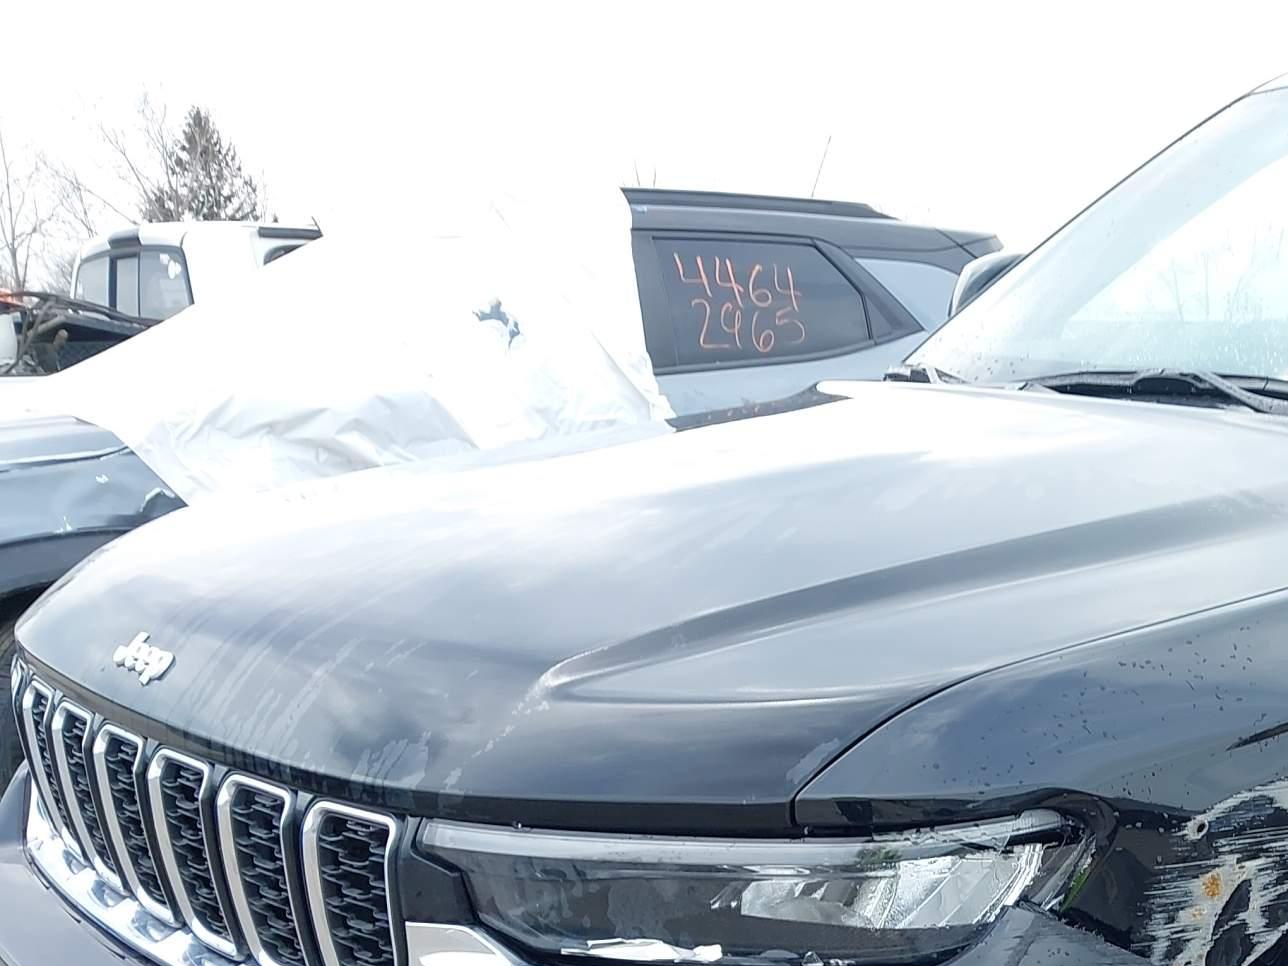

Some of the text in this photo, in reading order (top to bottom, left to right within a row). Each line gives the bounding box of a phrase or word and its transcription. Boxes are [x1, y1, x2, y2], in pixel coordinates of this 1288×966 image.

[673, 252, 802, 312] 4464
[691, 299, 806, 353] 2965
[112, 631, 175, 686] Jeep
